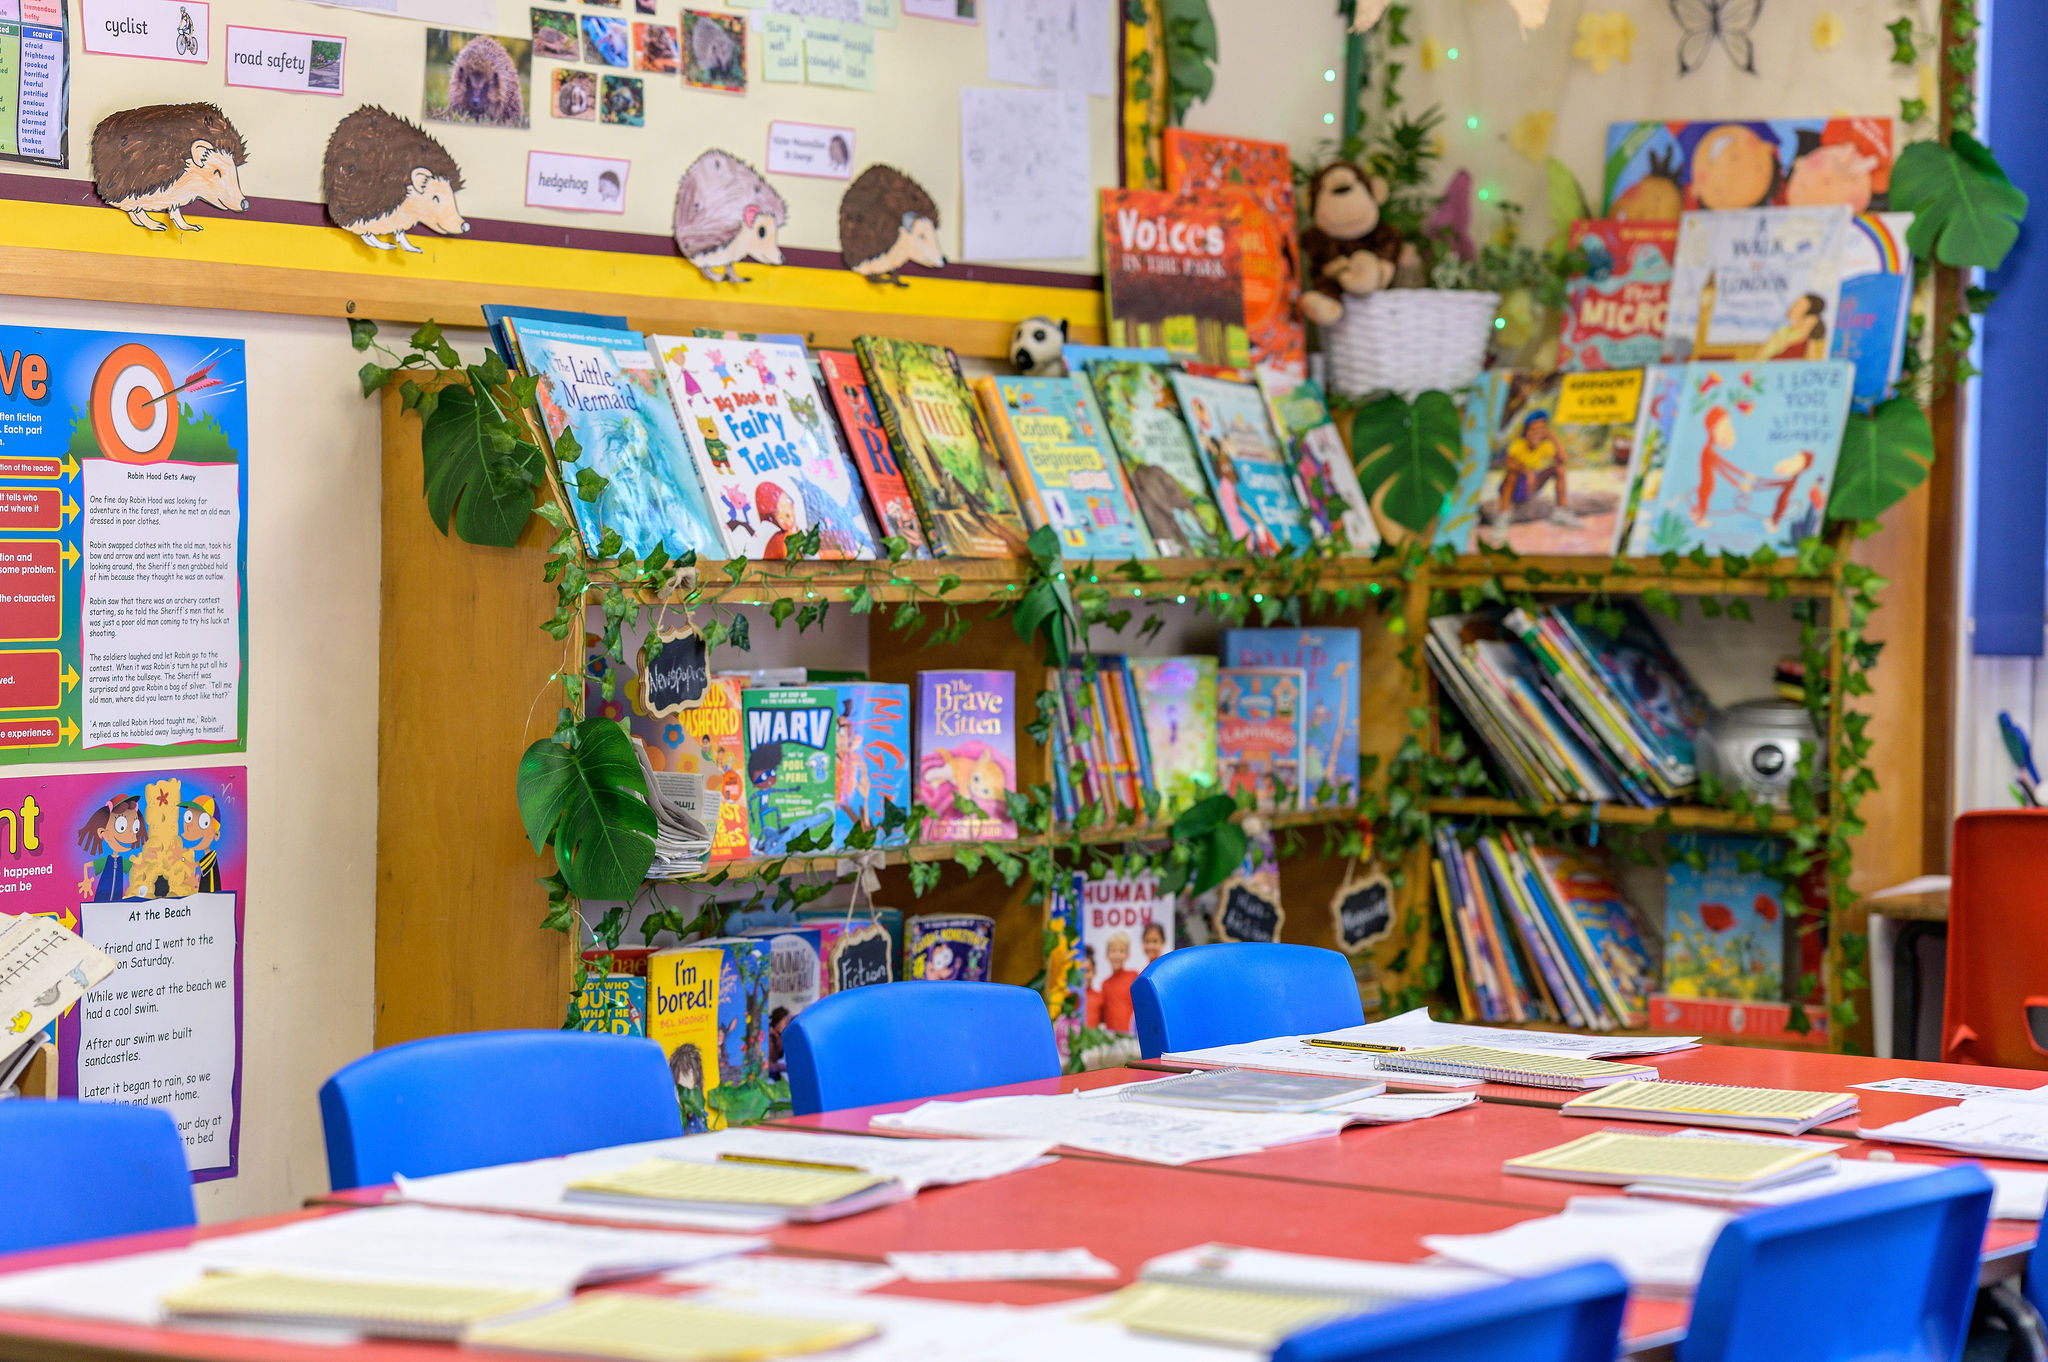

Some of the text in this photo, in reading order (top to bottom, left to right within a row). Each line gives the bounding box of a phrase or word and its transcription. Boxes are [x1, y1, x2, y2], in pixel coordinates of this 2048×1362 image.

[24, 3, 57, 14] tremendous
[24, 12, 40, 22] hefty
[105, 18, 148, 36] cyclist
[32, 30, 53, 40] scared
[25, 42, 43, 50] afraid
[24, 52, 55, 61] frightened
[234, 51, 305, 74] road safety
[24, 61, 48, 70] spooked
[24, 70, 49, 79] horrified
[23, 80, 44, 88] fearful
[23, 89, 49, 98] petrified
[22, 99, 45, 108] anxious
[22, 109, 49, 117] panicked
[22, 119, 47, 127] alarmed
[21, 128, 46, 136] terrified
[21, 137, 42, 145] shaken
[22, 147, 45, 155] startled
[538, 171, 589, 195] hedgehog
[1118, 208, 1225, 255] Voices
[554, 356, 616, 387] The Little
[560, 380, 639, 412] Mermaid
[17, 413, 42, 422] fiction
[914, 400, 964, 437] TREES
[4, 425, 42, 436] Each part
[724, 409, 786, 442] Fairy
[737, 442, 802, 476] Tales
[127, 472, 197, 482] Robin Hood Gets Away
[6, 493, 38, 502] tells who
[89, 496, 102, 504] One
[104, 496, 116, 504] fine
[117, 496, 128, 505] day
[129, 496, 146, 504] Robin
[147, 496, 163, 504] Hood
[176, 497, 197, 506] looking
[10, 504, 39, 512] where it
[140, 507, 161, 516] forest,
[162, 507, 178, 515] when
[89, 517, 114, 525] dressed
[116, 517, 121, 525] in
[137, 517, 161, 525] clothes.
[16, 553, 33, 562] and
[0, 565, 57, 575] some problem.
[0, 594, 56, 603] the characters
[951, 679, 972, 692] The
[934, 683, 1003, 713] Brave
[748, 708, 832, 751] MARV
[935, 711, 1001, 736] Kitten
[7, 728, 54, 738] experience.
[783, 760, 804, 771] POOL
[786, 772, 808, 783] PERIL
[3, 864, 53, 879] happened
[0, 881, 32, 893] can be
[128, 906, 191, 922] At the Beach
[1093, 907, 1152, 927] BODY
[104, 933, 214, 955] friend and I went to the
[116, 954, 175, 970] on Saturday.
[675, 959, 696, 986] I'm
[842, 958, 887, 989] Fiction
[86, 979, 227, 1003] While we were at the beach we
[657, 979, 712, 1015] bored!
[86, 1002, 159, 1020] had a cool swim.
[615, 1009, 629, 1017] HE
[660, 1014, 709, 1028] BEL MOONEY
[85, 1027, 193, 1050] After our swim we built
[84, 1051, 141, 1067] sandcastles.
[84, 1072, 211, 1098] Later it began to rain, so we
[132, 1089, 200, 1107] and went home.
[177, 1115, 222, 1131] our day at
[185, 1131, 214, 1146] to bed
